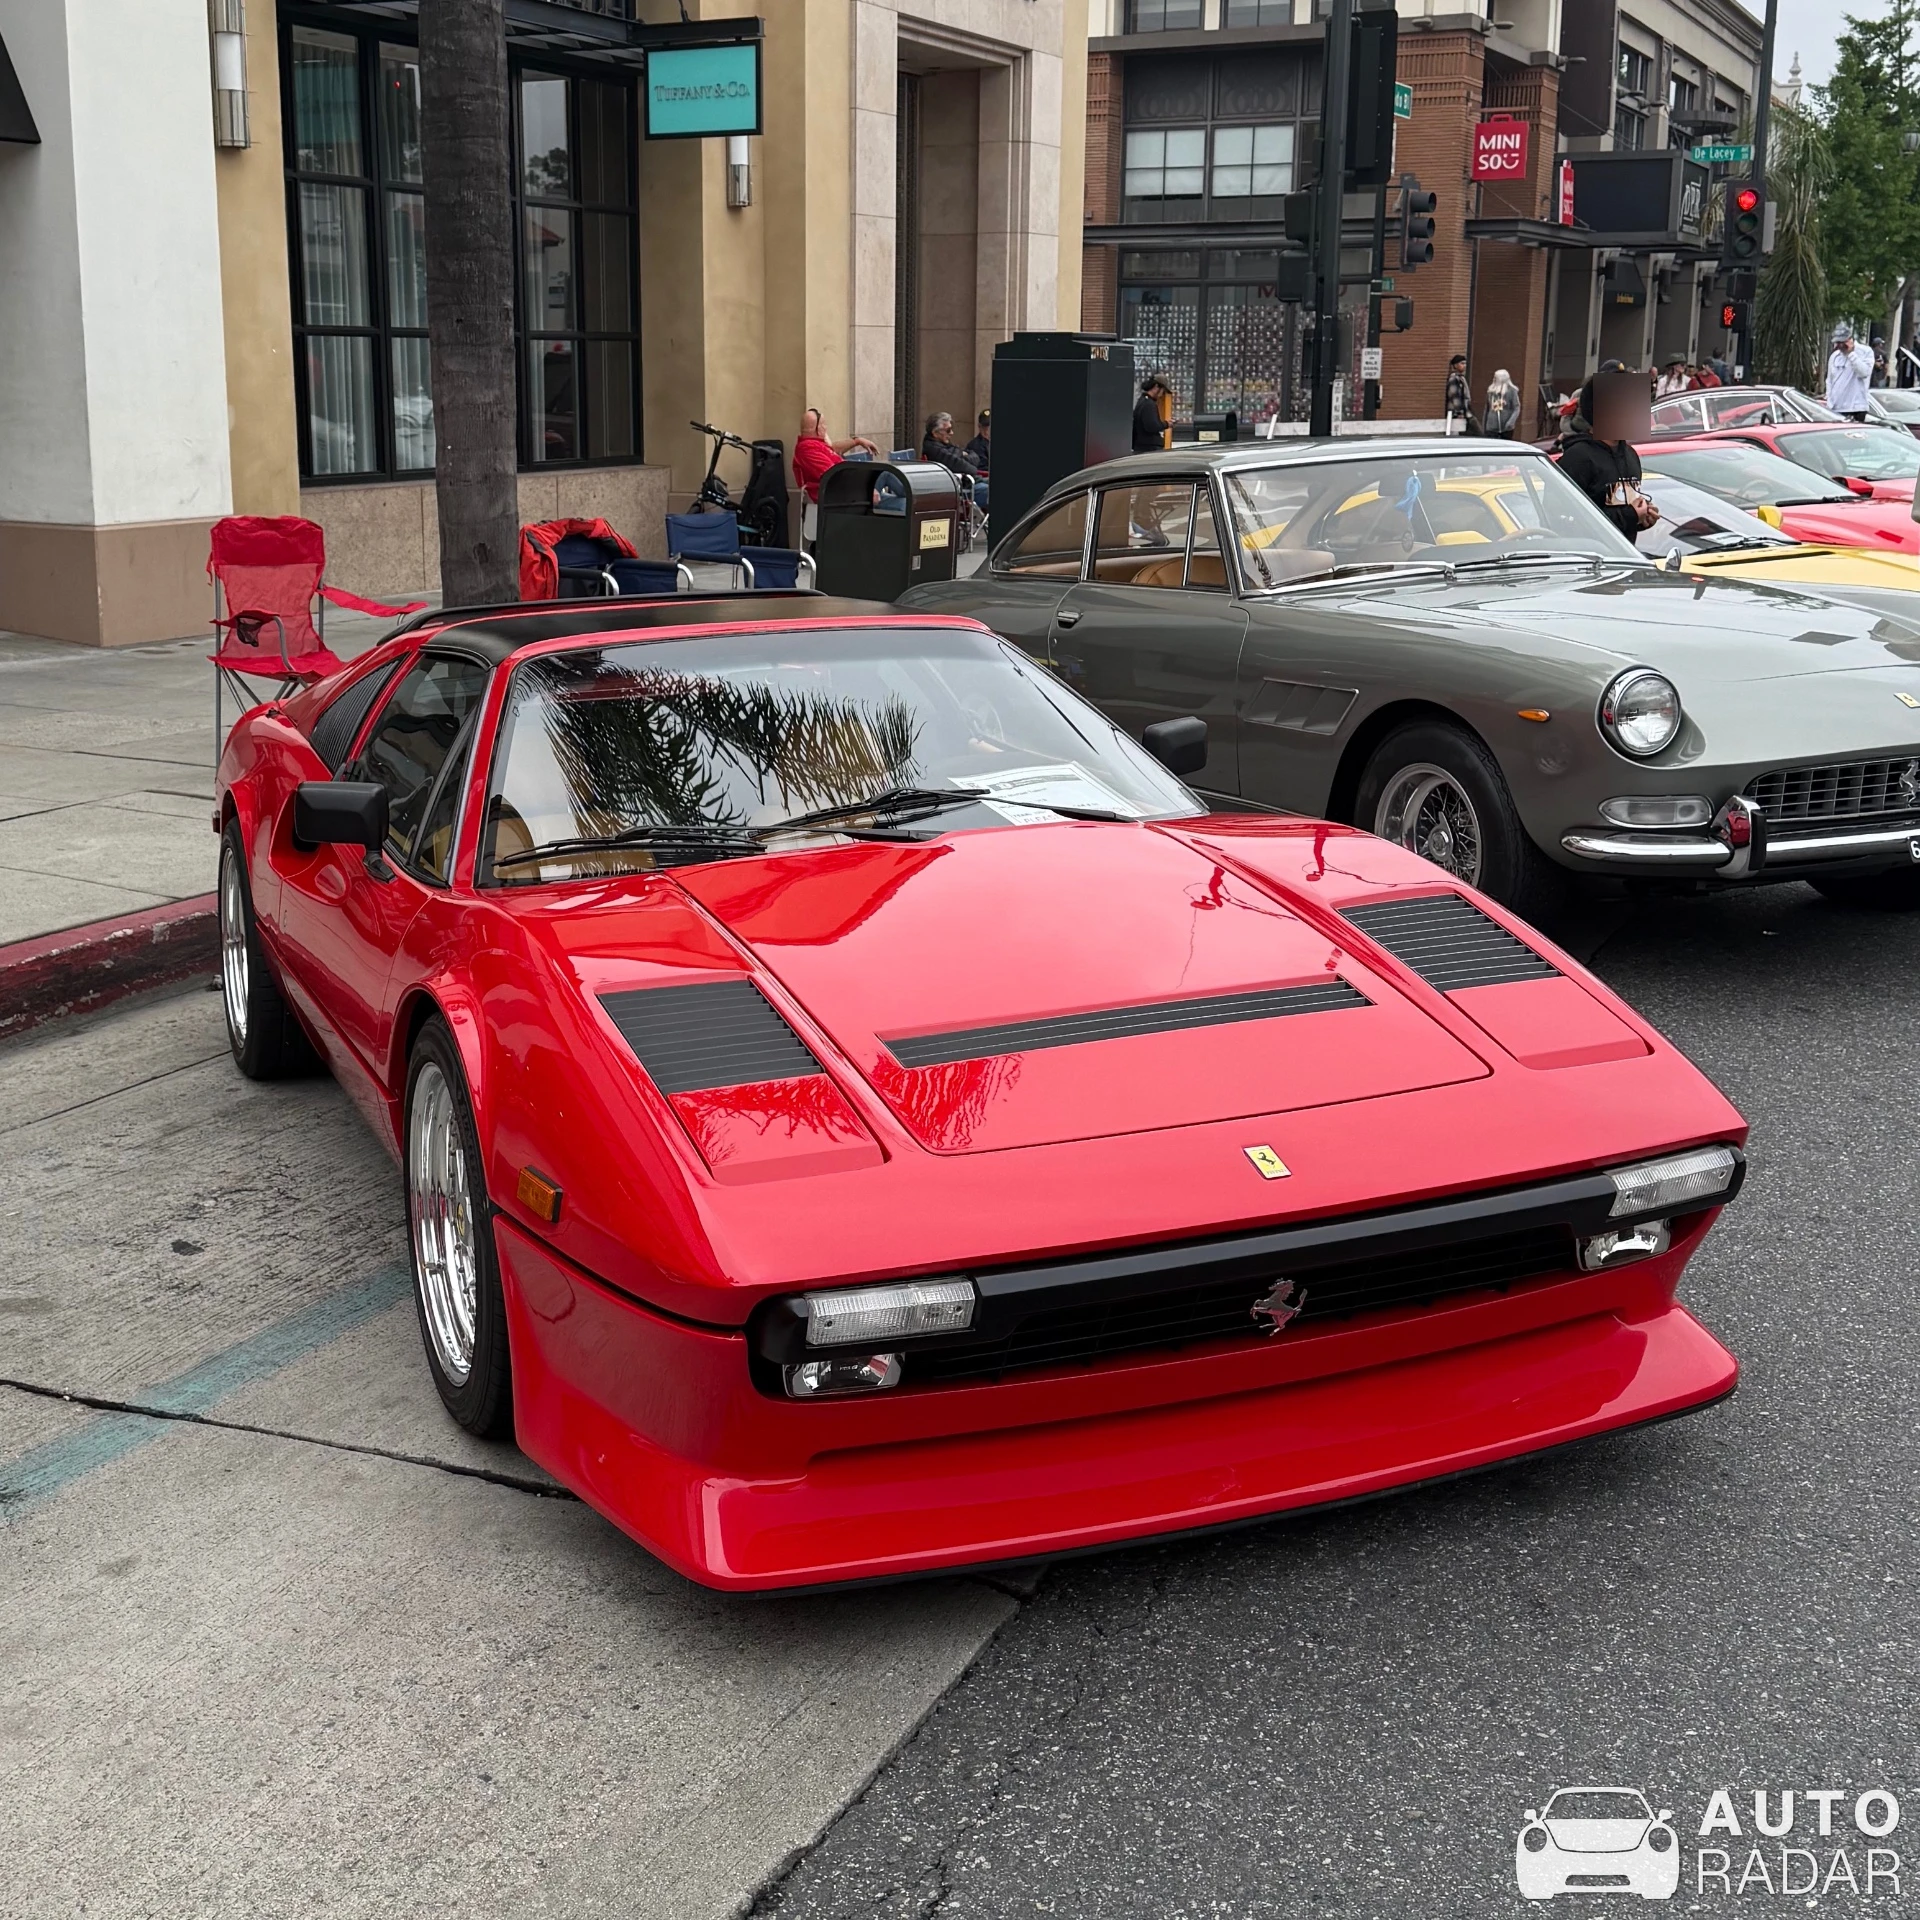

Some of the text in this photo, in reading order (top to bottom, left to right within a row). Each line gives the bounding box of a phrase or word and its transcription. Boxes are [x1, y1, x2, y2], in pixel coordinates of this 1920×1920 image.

[1480, 133, 1520, 150] MINI
[1694, 147, 1706, 159] De
[1709, 147, 1735, 161] Lacey
